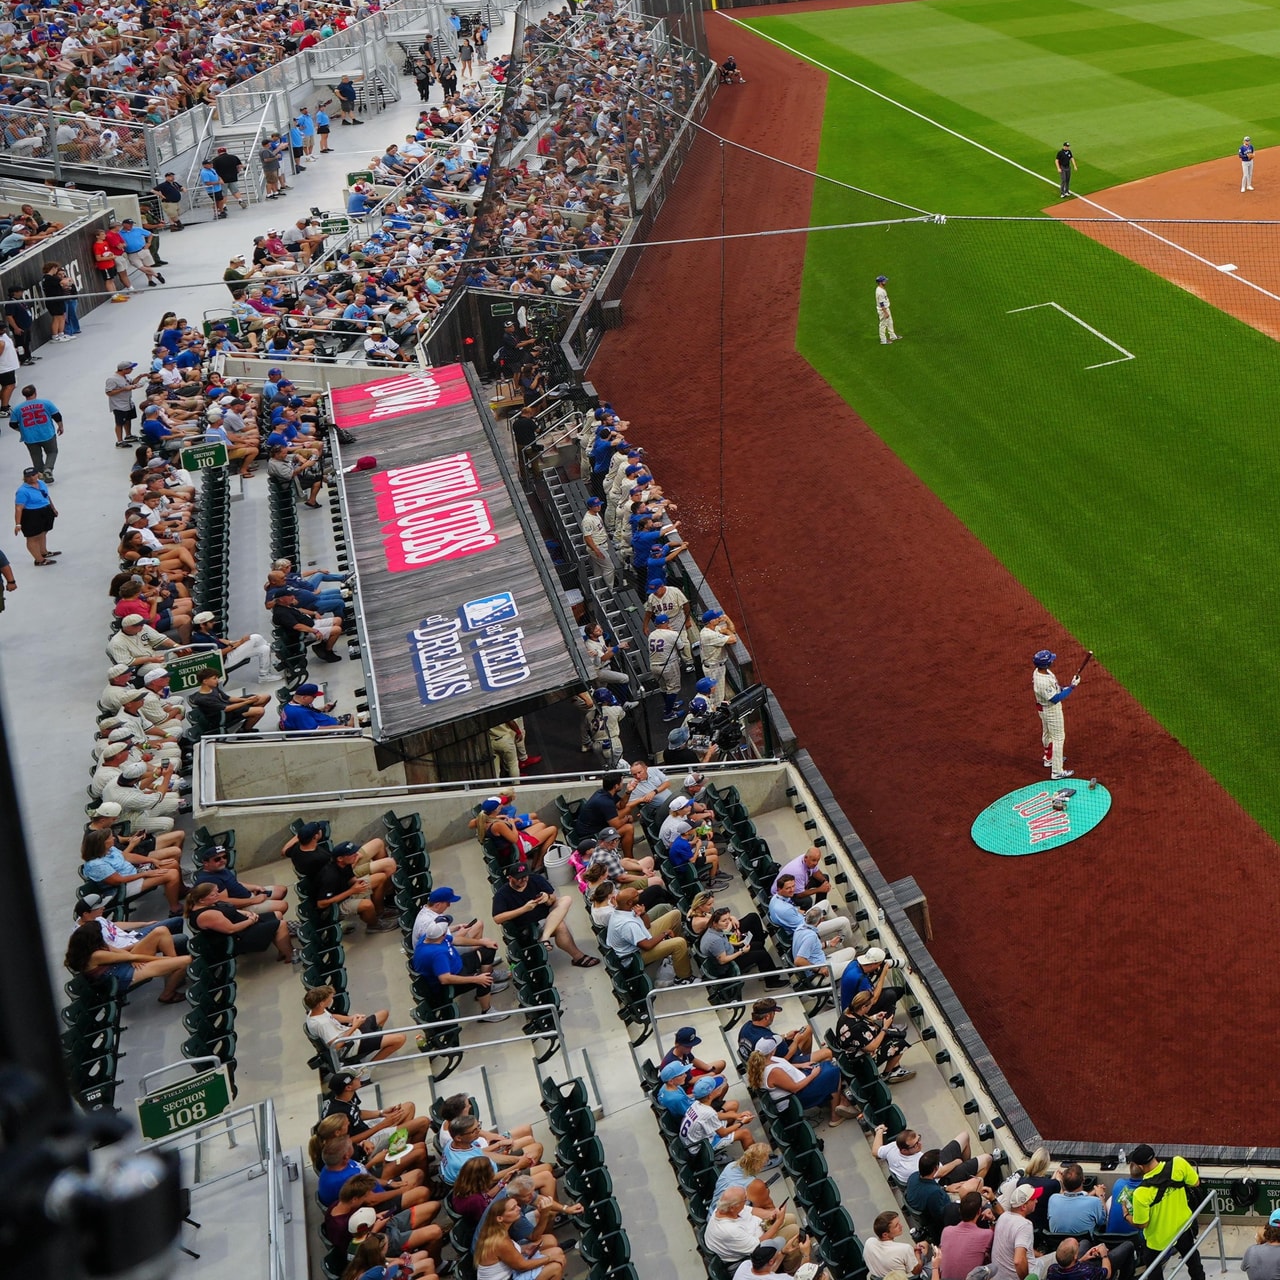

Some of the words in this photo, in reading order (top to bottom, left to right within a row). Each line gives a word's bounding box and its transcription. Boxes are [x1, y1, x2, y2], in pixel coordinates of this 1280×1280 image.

[365, 373, 441, 419] IOWA
[22, 409, 48, 428] 25
[197, 457, 214, 469] 110
[387, 452, 479, 516] IOWA
[396, 499, 498, 565] CUBS
[652, 603, 674, 613] CUBS
[650, 639, 664, 652] 52
[413, 617, 473, 702] DREAMS
[476, 627, 531, 689] FIELD
[178, 663, 208, 675] SECTION
[181, 673, 198, 688] 10
[1012, 791, 1071, 845] IOWA
[87, 1092, 102, 1101] 109
[162, 1089, 207, 1113] SECTION
[166, 1102, 207, 1131] 108
[681, 1119, 691, 1138] 6
